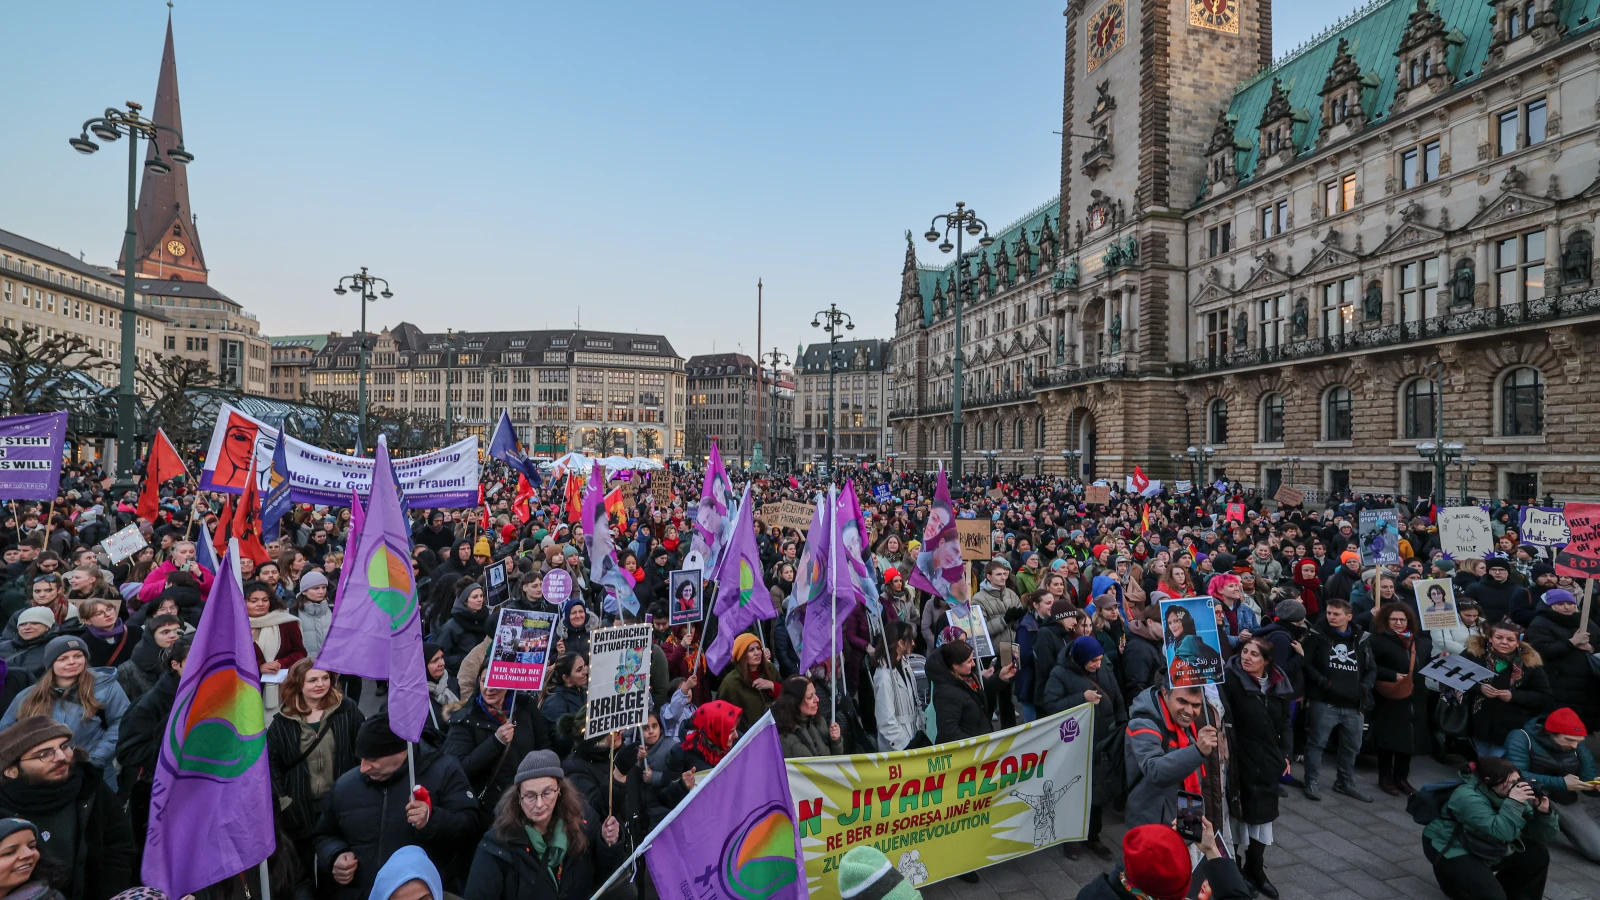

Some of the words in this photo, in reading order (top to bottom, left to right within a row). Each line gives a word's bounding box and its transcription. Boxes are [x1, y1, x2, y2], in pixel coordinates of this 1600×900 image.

[5, 436, 48, 445] STEHT
[12, 461, 50, 469] WILL!
[288, 470, 319, 486] Nein
[324, 480, 341, 488] zu
[418, 476, 466, 488] Frauen!
[342, 471, 366, 479] von
[1530, 511, 1541, 524] I'm
[1570, 518, 1590, 528] KEEP
[1522, 528, 1547, 542] What's
[1548, 537, 1563, 546] your
[1577, 543, 1590, 552] OFF
[1570, 558, 1597, 568] BOD
[594, 626, 650, 643] PATRIARCHAT
[593, 638, 648, 654] ENTWAFFNEN!
[492, 674, 539, 682] VERÄNDERUNG!
[590, 690, 645, 719] KRIEGE
[589, 709, 644, 736] BEENDEN
[928, 754, 952, 773] MIT
[888, 764, 902, 780] BI
[837, 773, 946, 826] JIYAN
[957, 750, 1048, 799] AZADI
[826, 832, 842, 852] RE
[846, 825, 872, 845] BER
[875, 822, 889, 836] BI
[891, 811, 942, 835] ŞOREŞA
[944, 799, 970, 820] JINÊ
[973, 796, 992, 811] WE
[823, 850, 846, 873] ZU
[868, 812, 990, 854] AUENREVOLUTION
